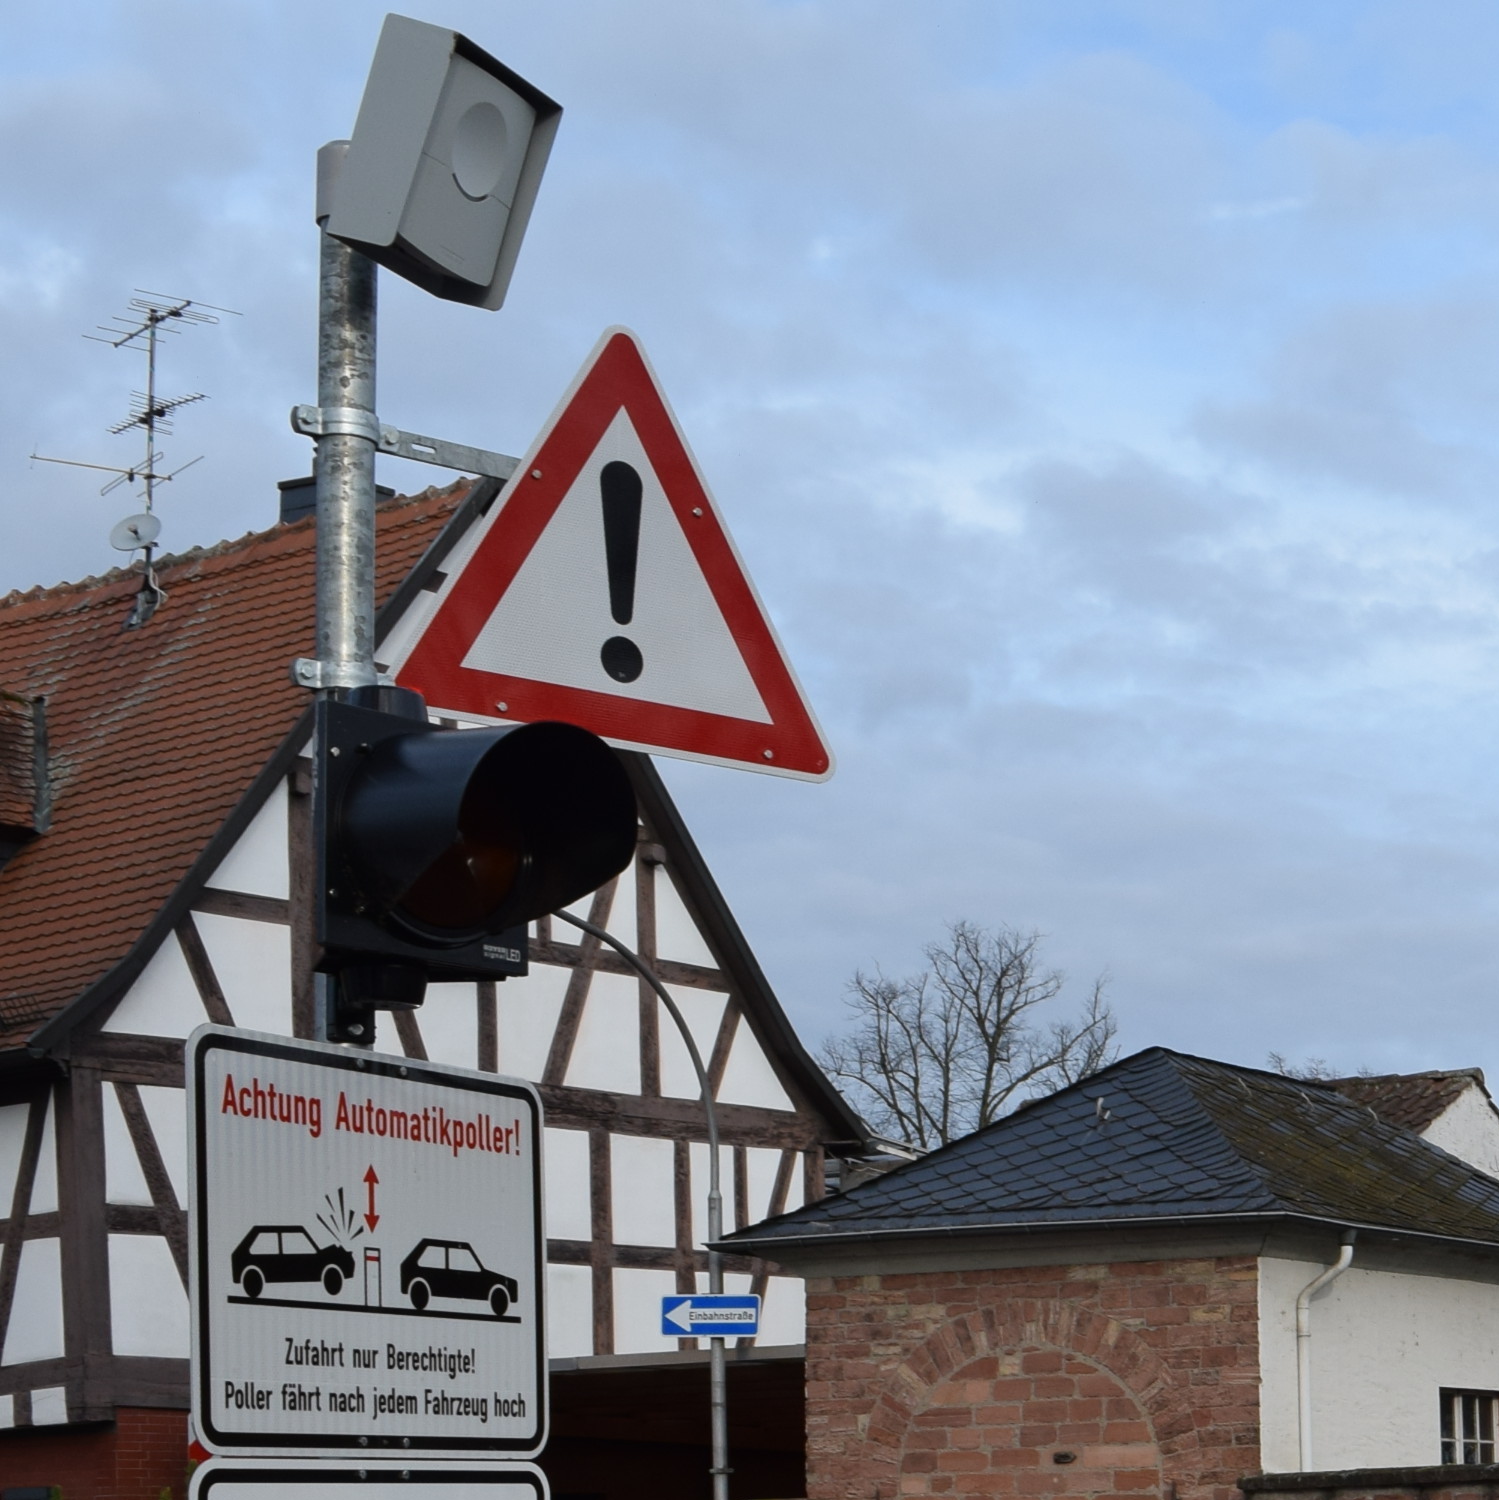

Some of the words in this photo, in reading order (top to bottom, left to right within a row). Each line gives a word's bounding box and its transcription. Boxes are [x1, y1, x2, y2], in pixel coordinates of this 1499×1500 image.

[221, 1073, 322, 1138] Achtung
[335, 1091, 521, 1157] Automatikpoller!
[688, 1311, 753, 1321] Einbahnstraße
[285, 1337, 345, 1369] Zufahrt
[352, 1346, 379, 1370] nur
[386, 1343, 476, 1380] Berechtigte!
[224, 1381, 273, 1412] Poller
[281, 1383, 322, 1412] fährt
[329, 1386, 366, 1414] nach
[372, 1387, 418, 1420] jedem
[424, 1388, 489, 1423] Fahrzeug
[494, 1391, 526, 1419] hoch
